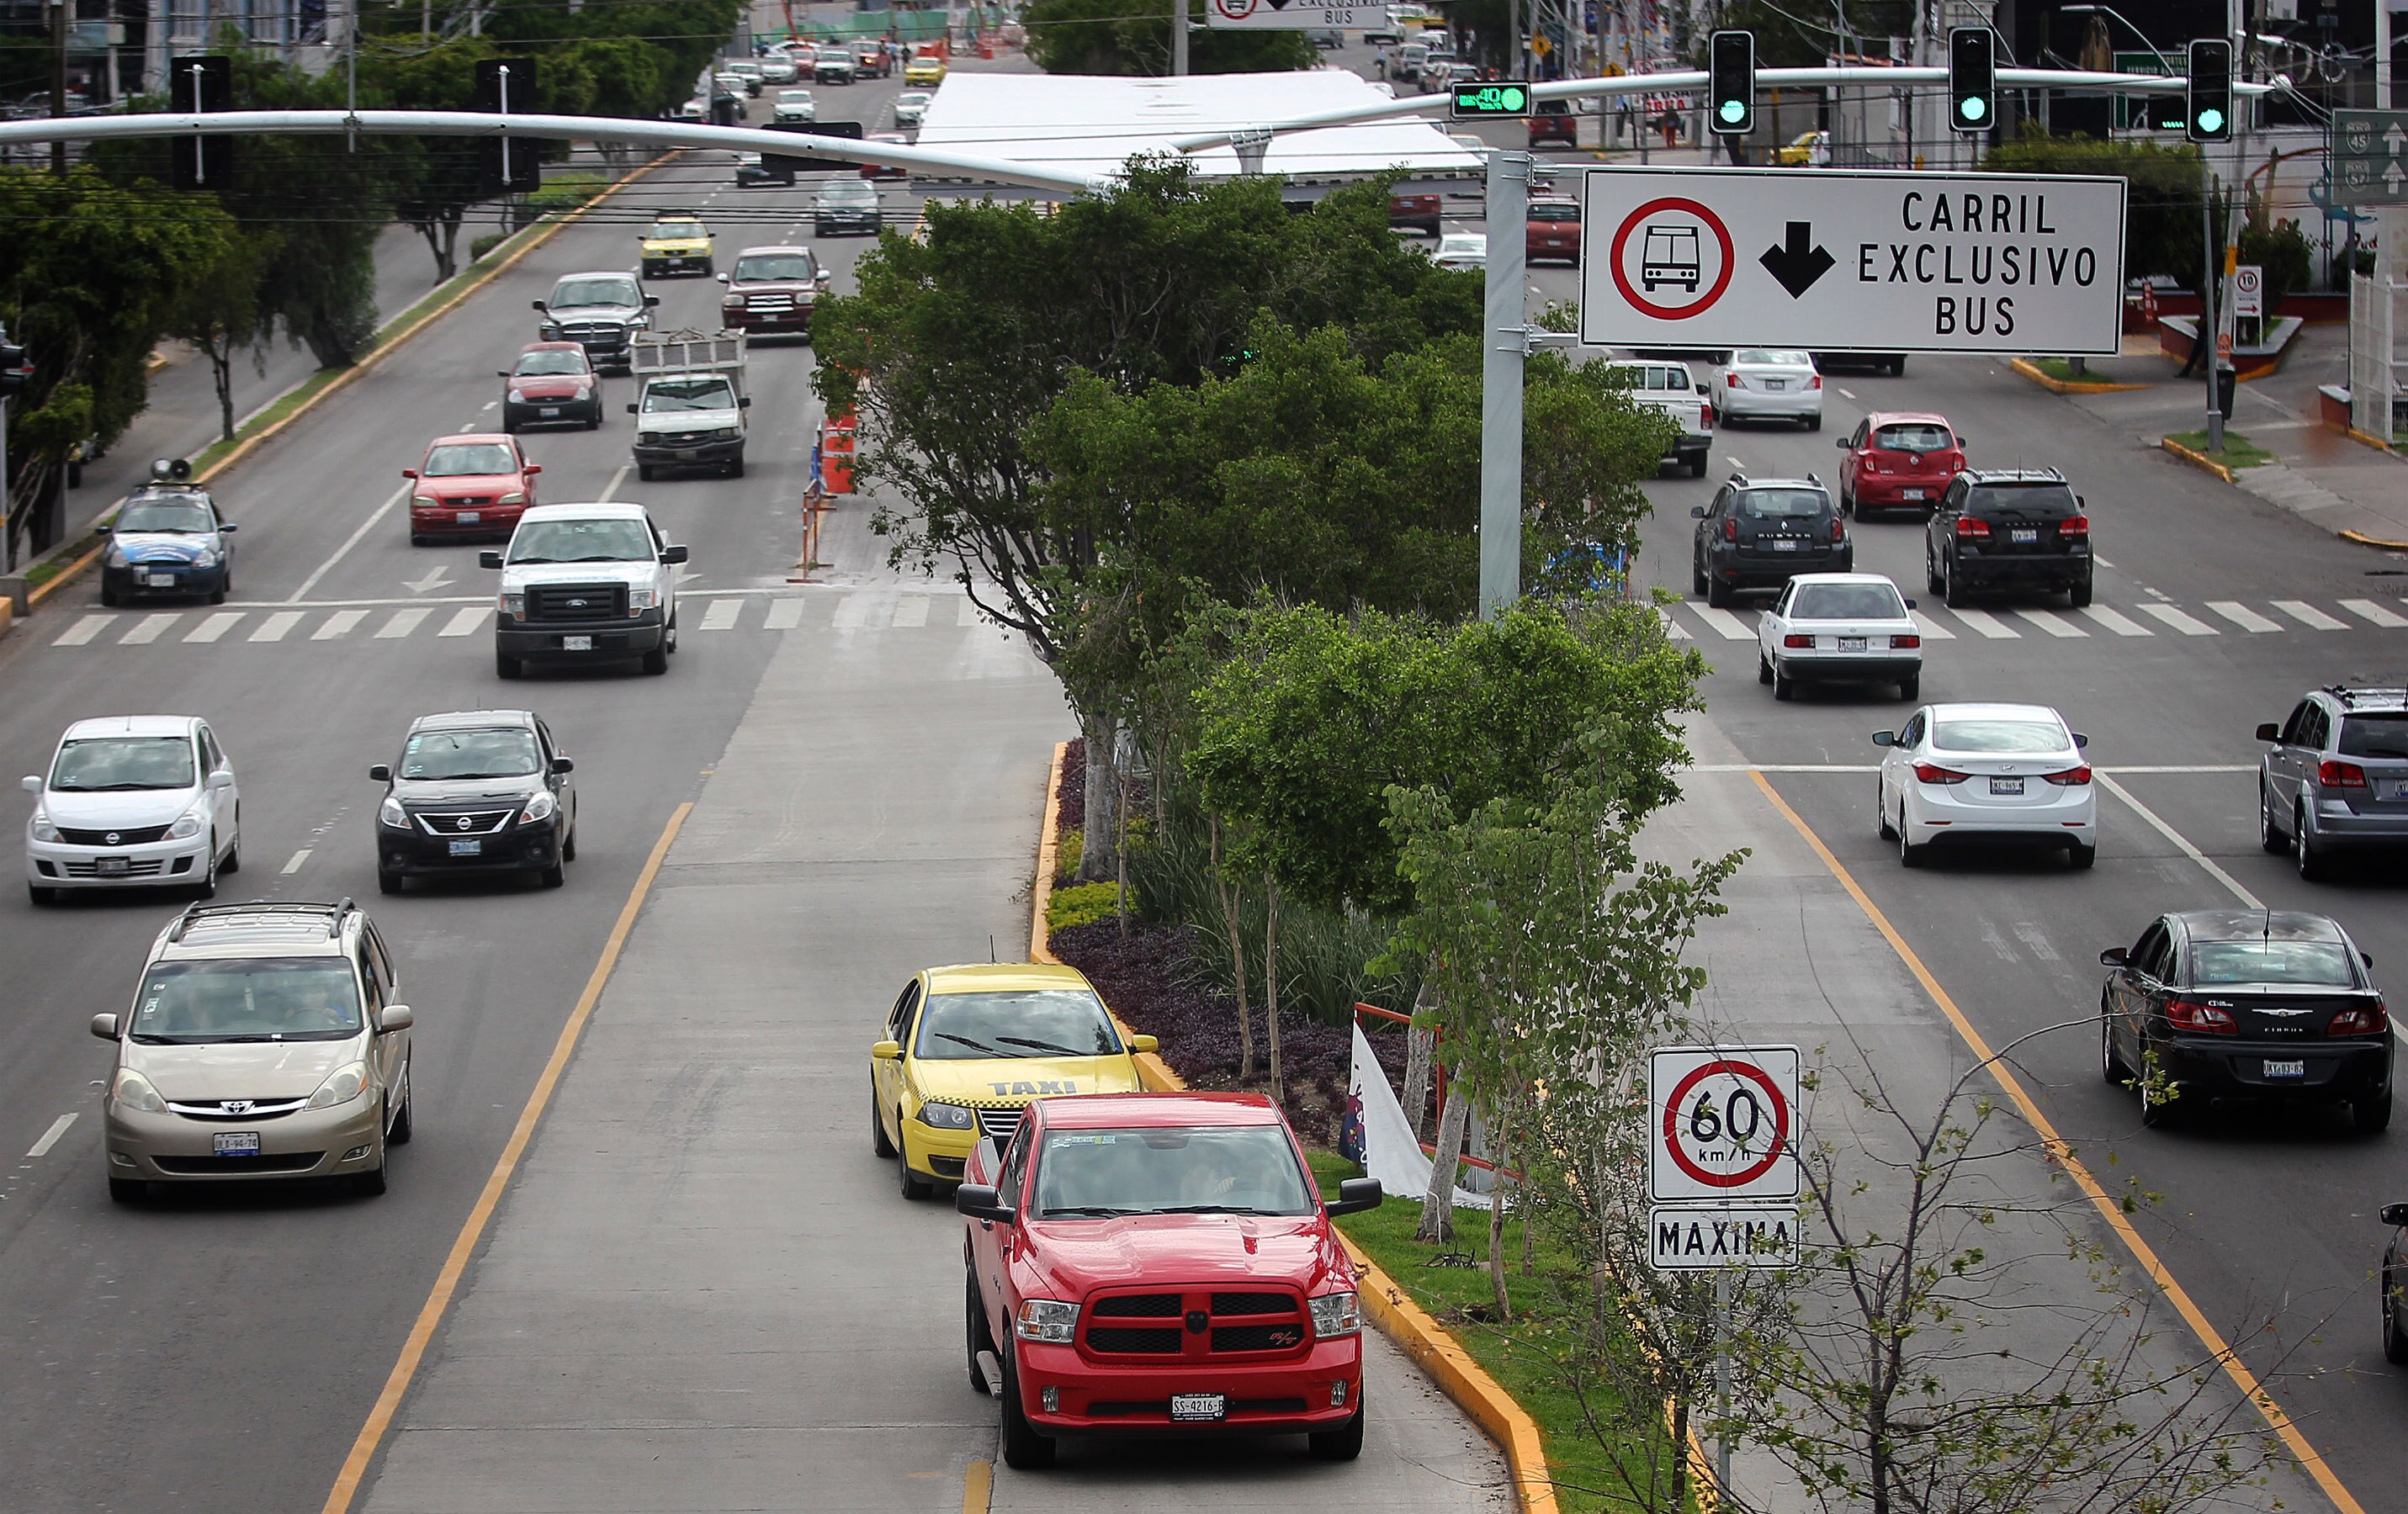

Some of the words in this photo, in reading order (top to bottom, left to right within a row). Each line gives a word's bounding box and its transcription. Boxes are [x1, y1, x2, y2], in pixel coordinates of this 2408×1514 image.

[1324, 10, 1353, 24] BUS
[1479, 87, 1501, 103] 40
[2350, 133, 2367, 148] 45
[1901, 192, 2056, 234] CARRIL
[1858, 243, 2097, 287] EXCLUSIVO
[2242, 275, 2254, 286] 10
[1936, 296, 2014, 336] BUS
[987, 1080, 1077, 1096] TAXI
[1690, 1088, 1759, 1143] 60
[1698, 1147, 1751, 1162] km/h
[1658, 1220, 1791, 1256] MAXIMA
[1174, 1400, 1224, 1412] SS-4216-B
